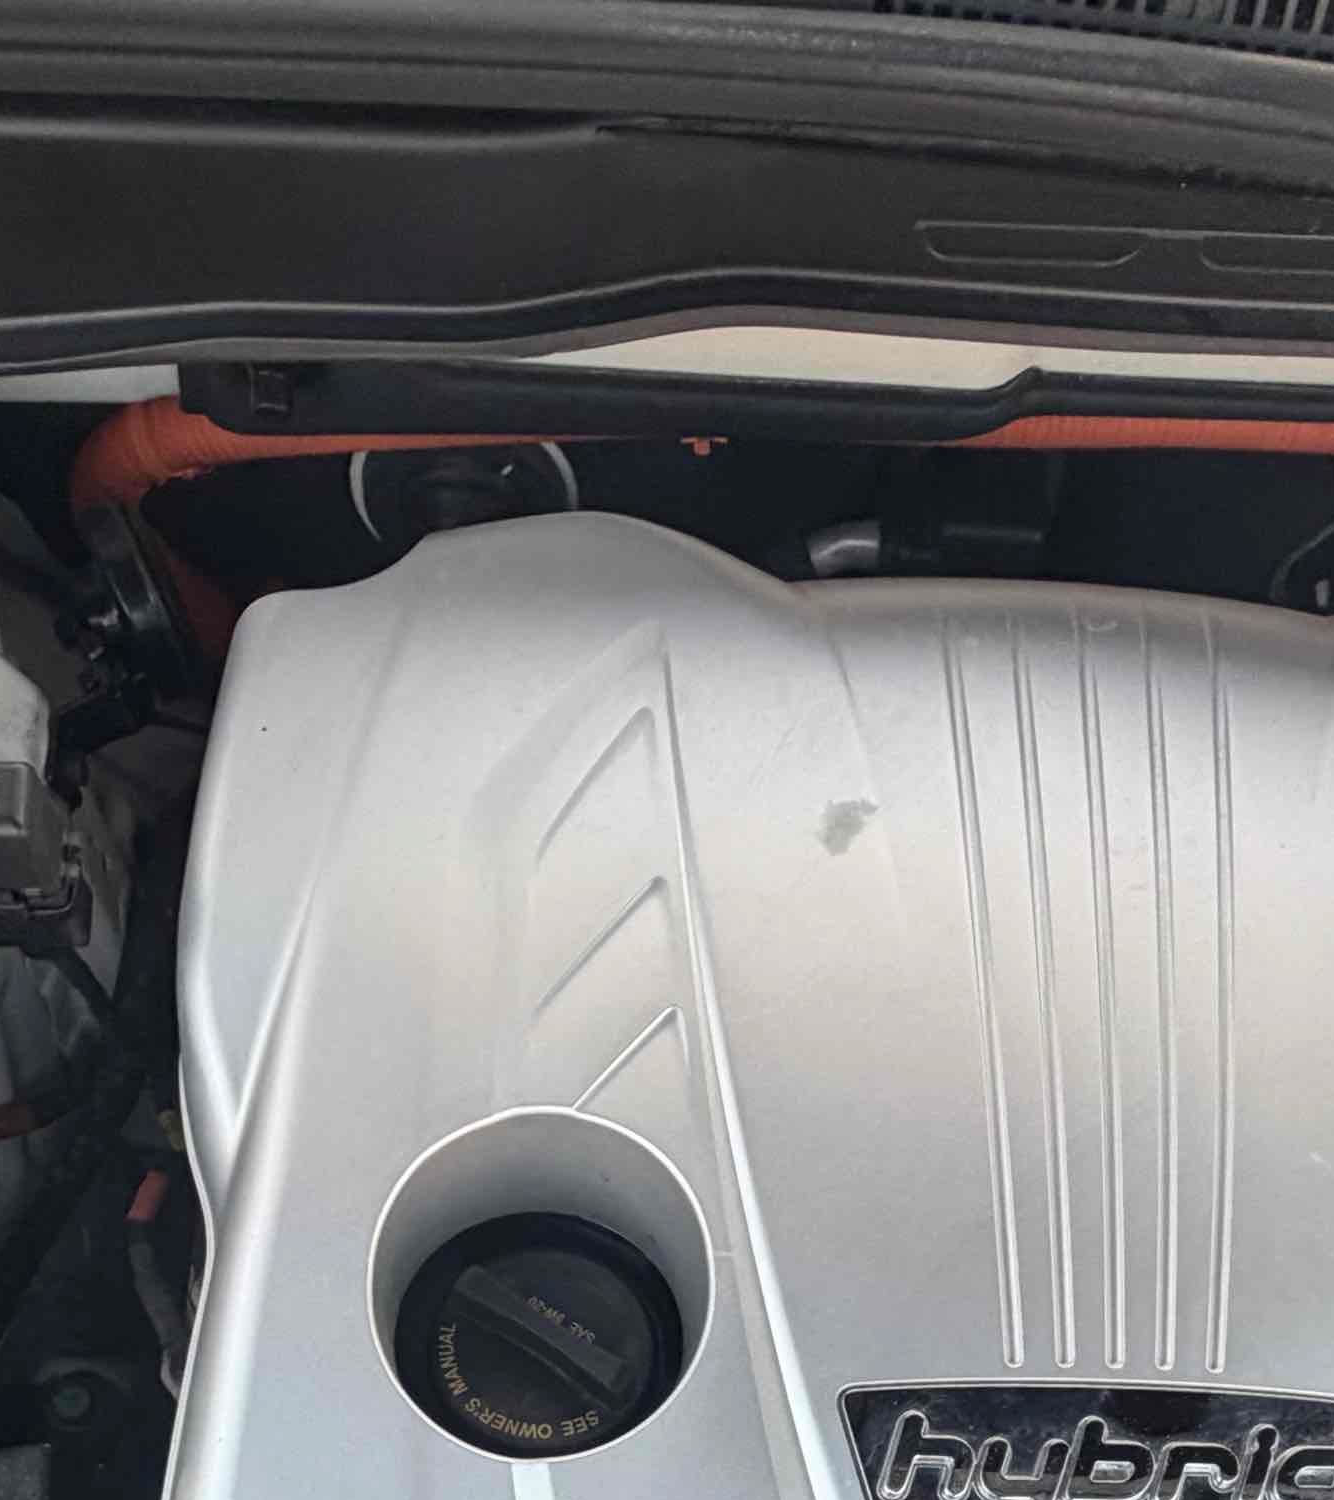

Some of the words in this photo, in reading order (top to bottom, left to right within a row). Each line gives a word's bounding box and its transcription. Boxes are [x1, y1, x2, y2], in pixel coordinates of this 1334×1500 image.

[437, 1322, 468, 1394] MANUAL
[464, 1397, 553, 1440] OWNER'S
[560, 1410, 600, 1437] SEE
